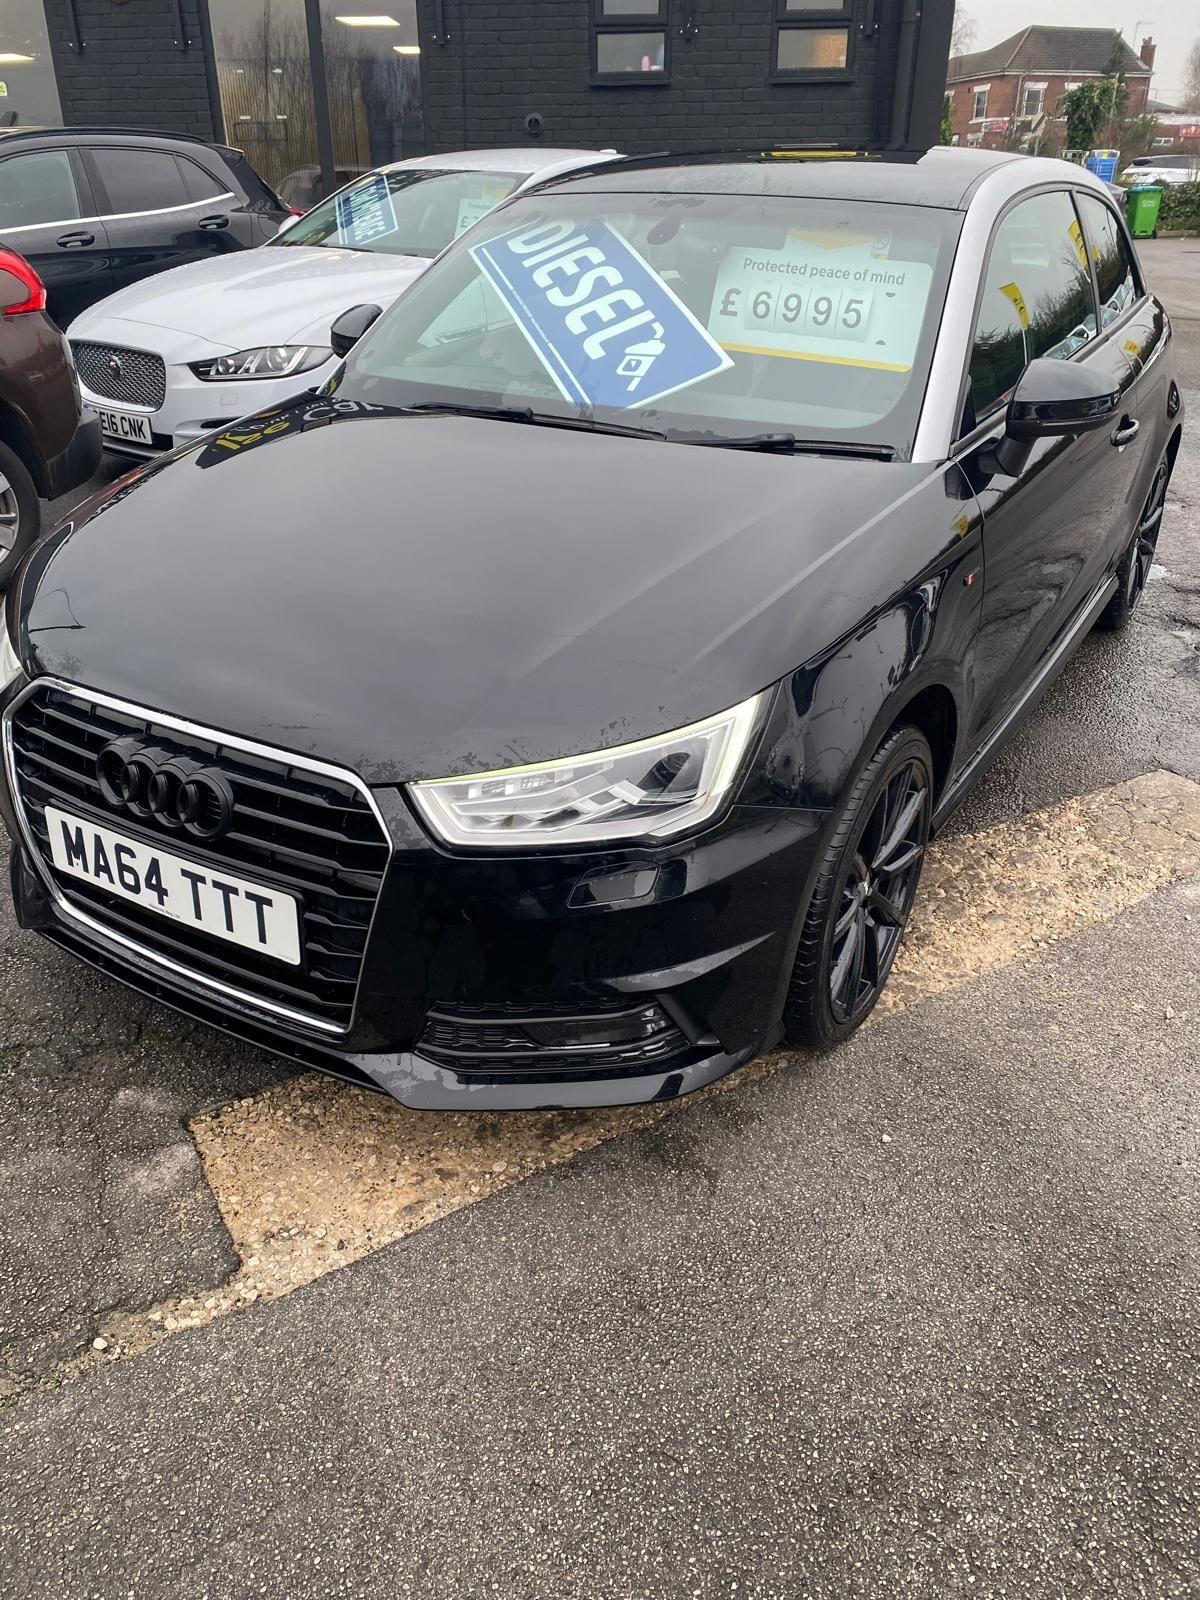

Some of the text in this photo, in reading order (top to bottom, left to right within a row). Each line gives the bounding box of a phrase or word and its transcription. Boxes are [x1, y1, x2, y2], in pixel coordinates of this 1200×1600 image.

[506, 218, 656, 361] DIESEL
[743, 257, 906, 286] Protected peace of mind
[94, 410, 147, 440] E16 CNK
[60, 819, 274, 945] MA64 TTT
